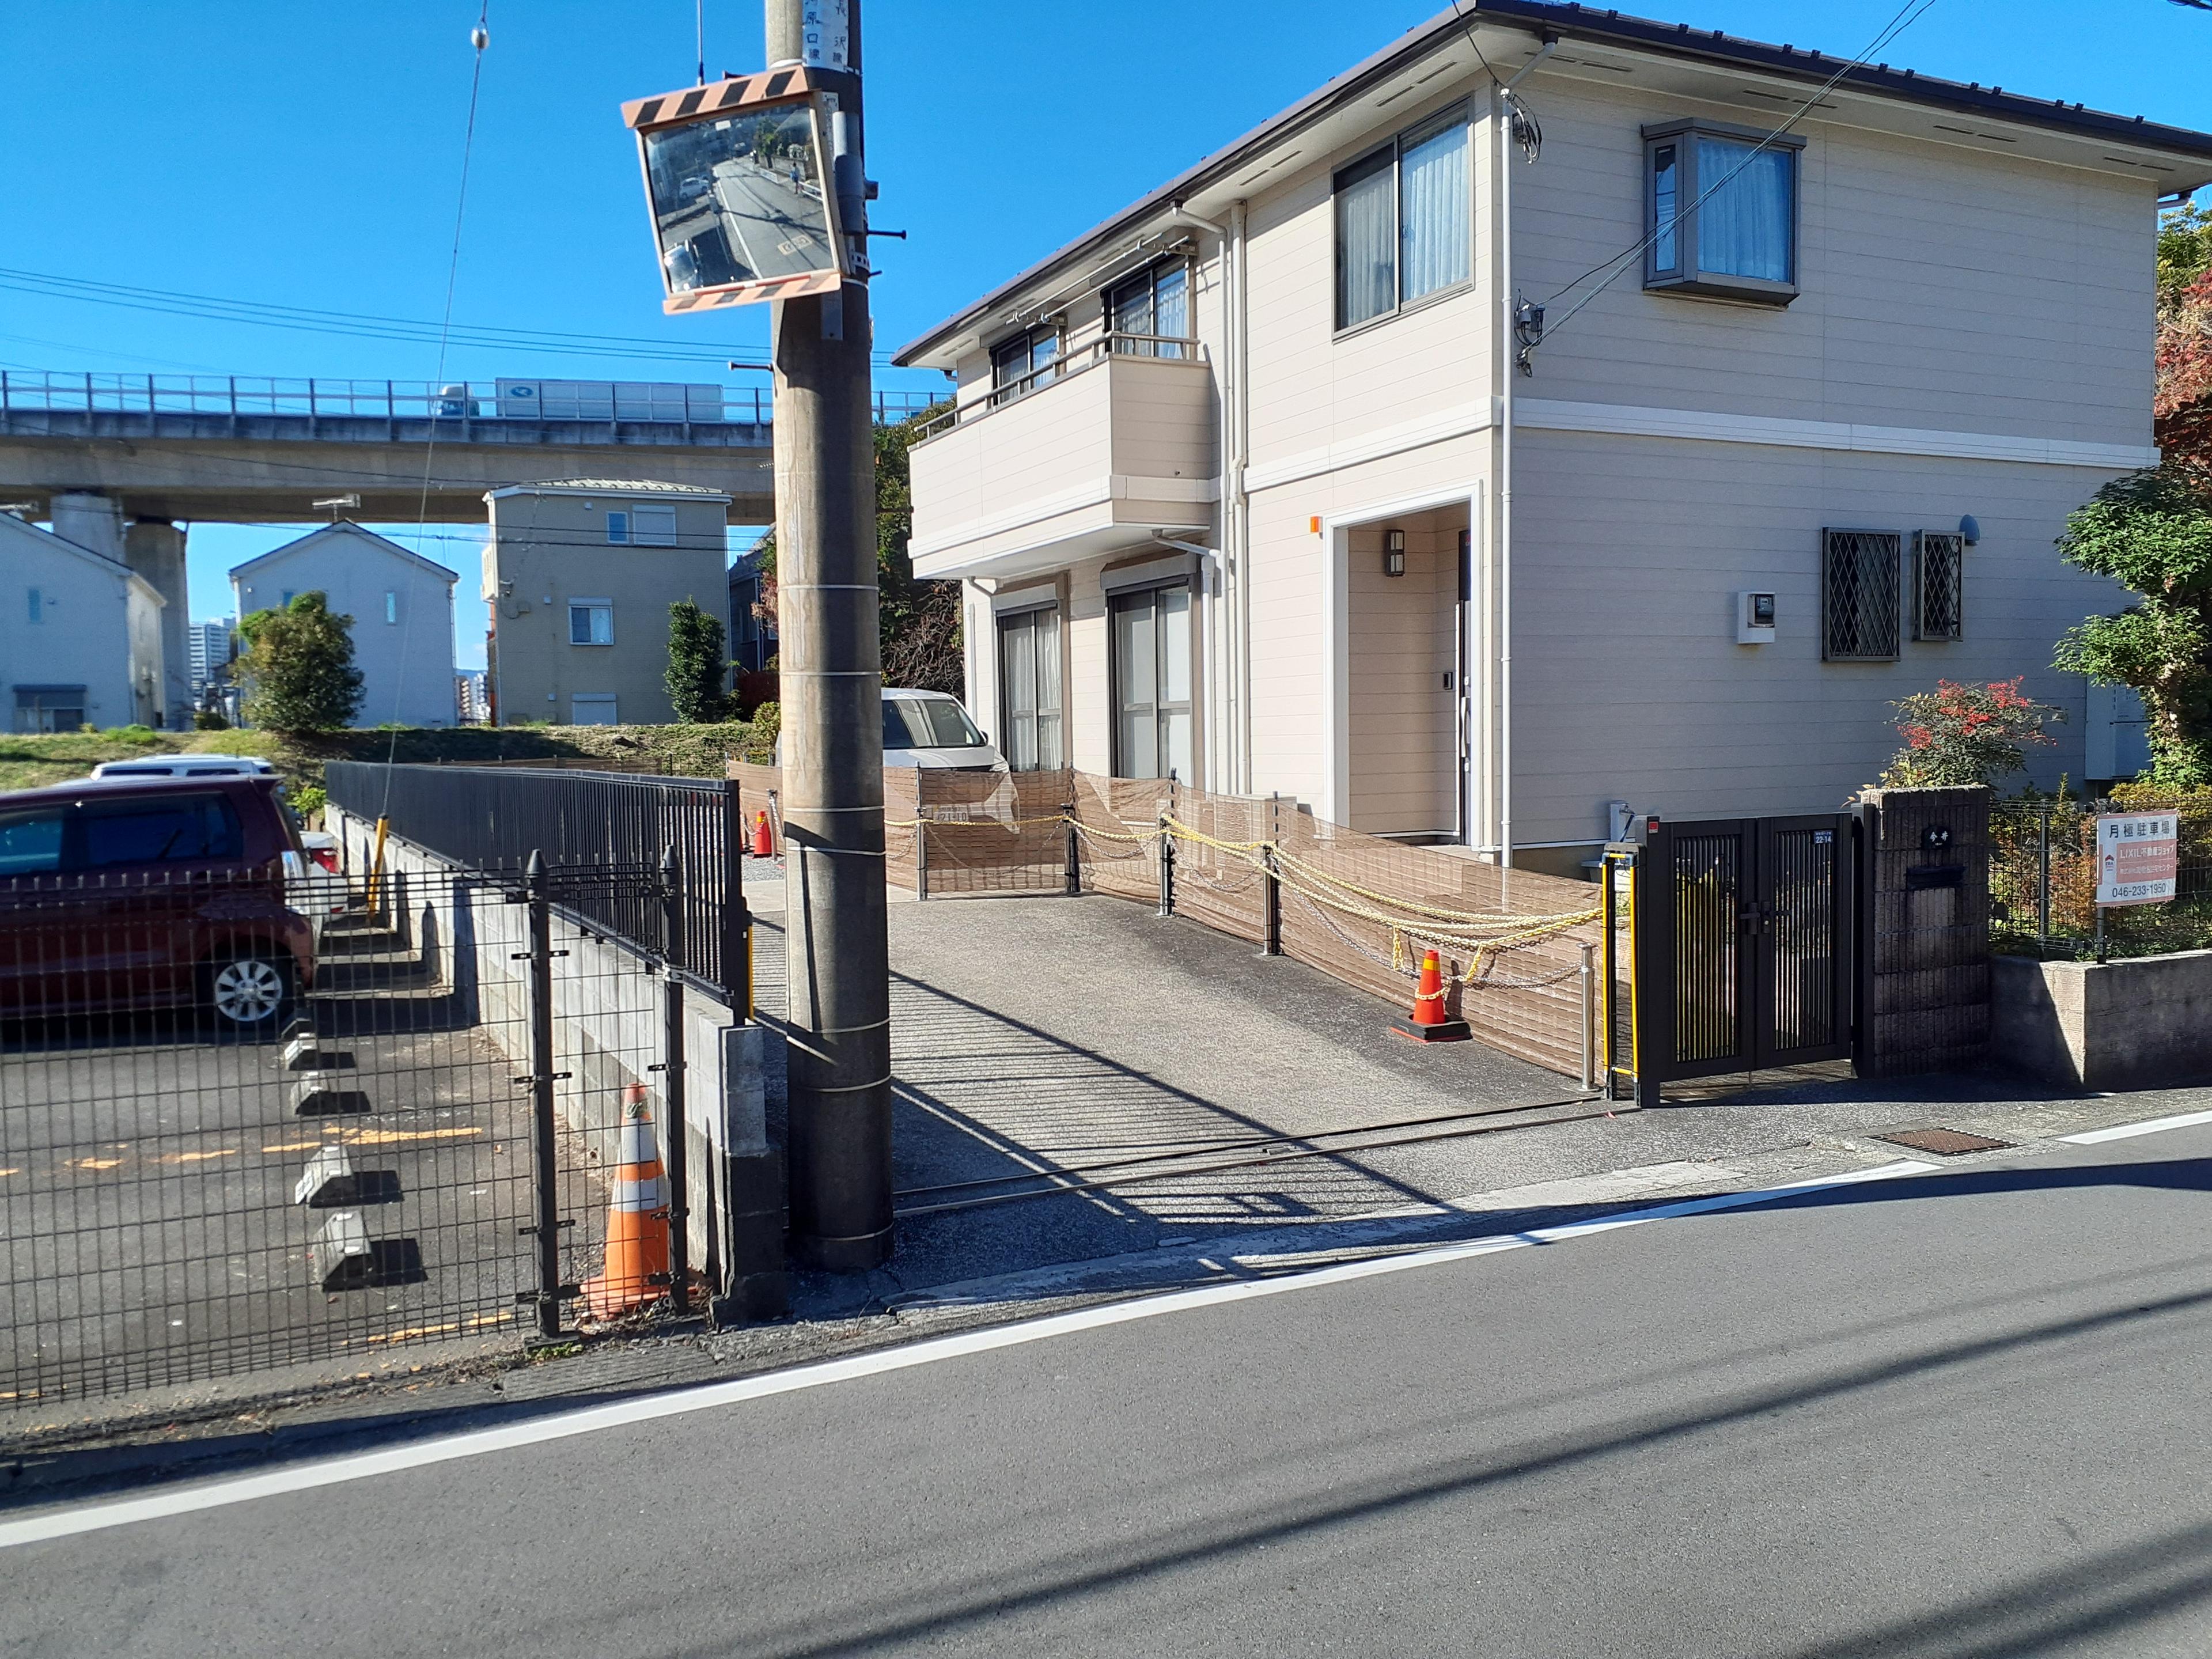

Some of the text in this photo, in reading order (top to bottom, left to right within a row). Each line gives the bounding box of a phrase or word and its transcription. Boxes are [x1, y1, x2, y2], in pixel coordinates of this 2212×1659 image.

[2109, 820, 2170, 839] 月極駐車場
[1816, 835, 1832, 844] 22-14
[2112, 882, 2166, 898] 046-233-1950
